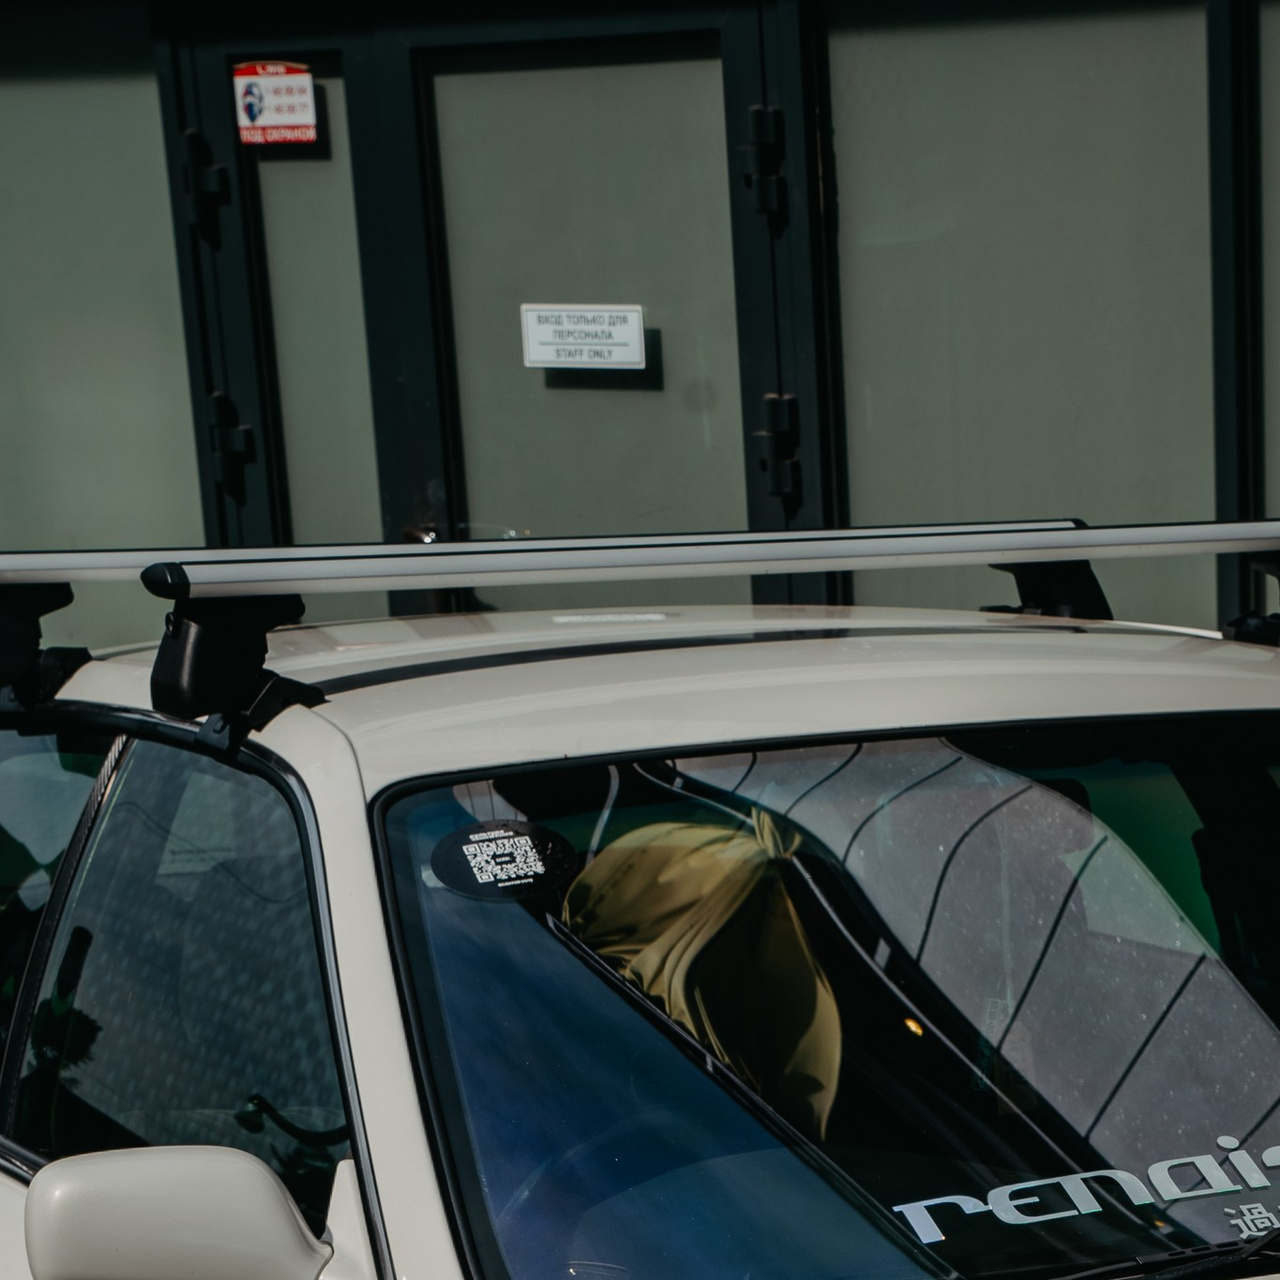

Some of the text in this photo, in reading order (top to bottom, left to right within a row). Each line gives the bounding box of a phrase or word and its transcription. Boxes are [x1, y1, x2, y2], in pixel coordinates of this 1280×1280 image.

[537, 314, 628, 327] ВХОД ТОЛЬКО ДЛЯ
[553, 329, 613, 340] ПЕРСОНАЛА
[555, 348, 613, 360] STAFF ONLY
